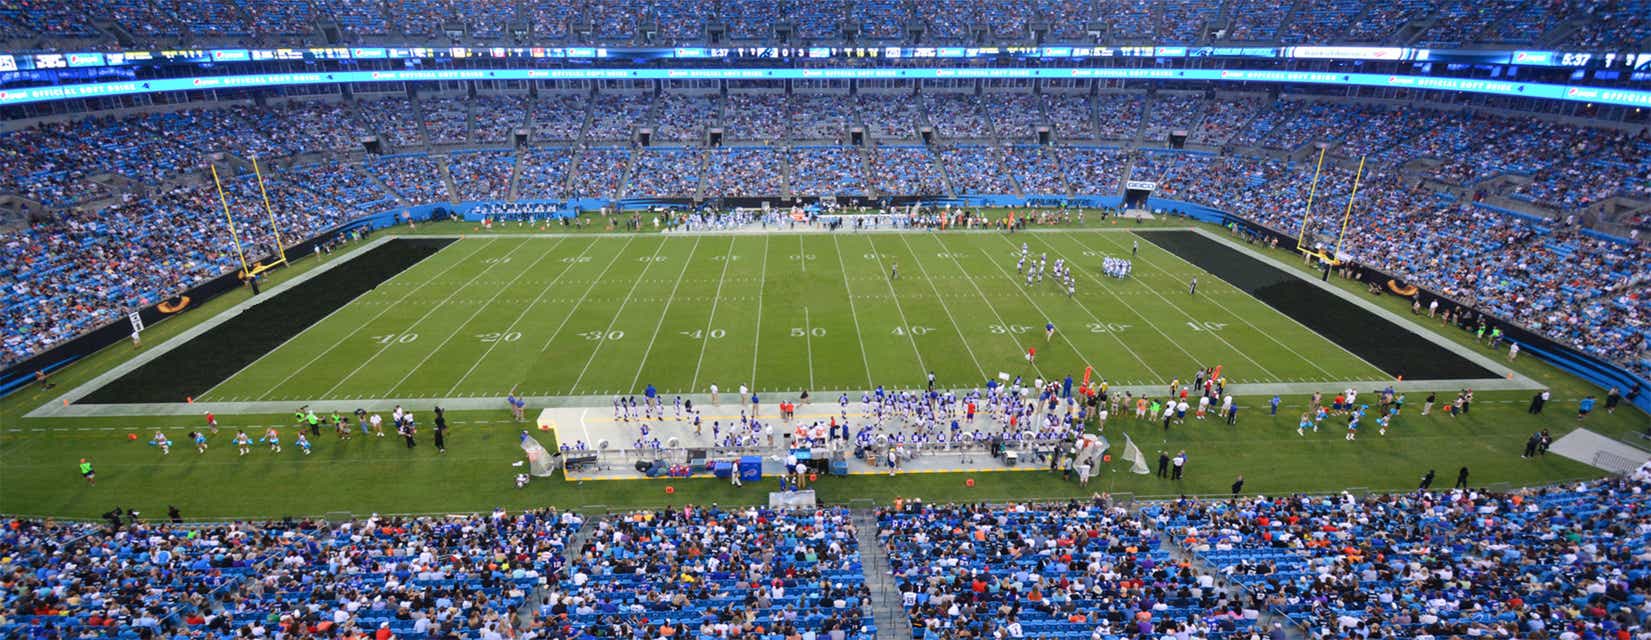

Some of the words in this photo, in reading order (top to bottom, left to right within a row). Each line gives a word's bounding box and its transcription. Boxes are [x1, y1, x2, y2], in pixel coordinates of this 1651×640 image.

[1562, 53, 1592, 66] 5:37
[32, 87, 77, 98] OFFICIAL
[79, 85, 105, 94] SOFT
[107, 83, 137, 92] DRINK
[891, 325, 929, 336] 40
[989, 323, 1027, 334] 30
[1085, 322, 1124, 333] 20
[1185, 320, 1222, 332] 10
[377, 332, 419, 344] 10
[480, 331, 523, 343] 20
[585, 330, 625, 341] 30
[687, 328, 727, 339] 40
[790, 327, 828, 338] 50
